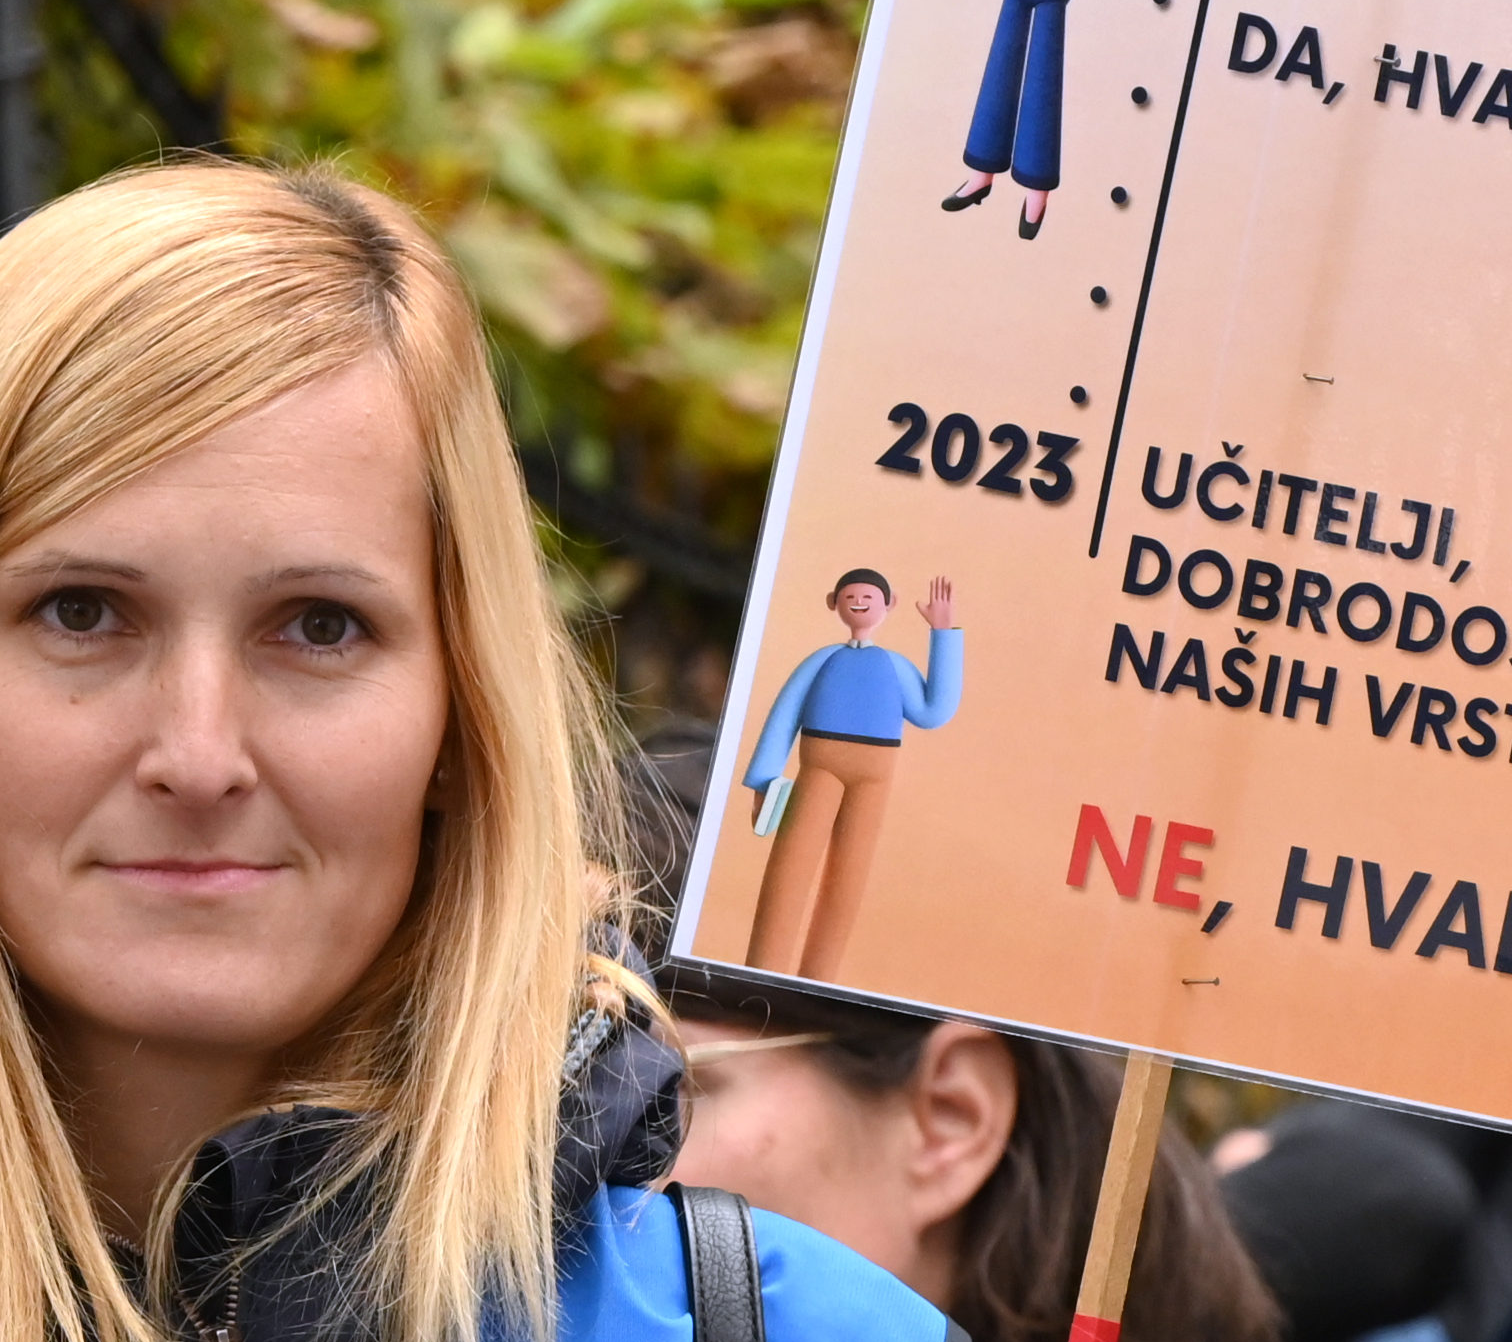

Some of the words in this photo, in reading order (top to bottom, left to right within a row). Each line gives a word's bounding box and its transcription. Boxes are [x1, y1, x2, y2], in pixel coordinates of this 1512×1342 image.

[1227, 12, 1345, 105] DA,
[875, 402, 1081, 505] 2023
[1141, 441, 1471, 584] UČITELJI,
[1104, 623, 1339, 727] NAŠIH
[1064, 804, 1234, 935] NE,
